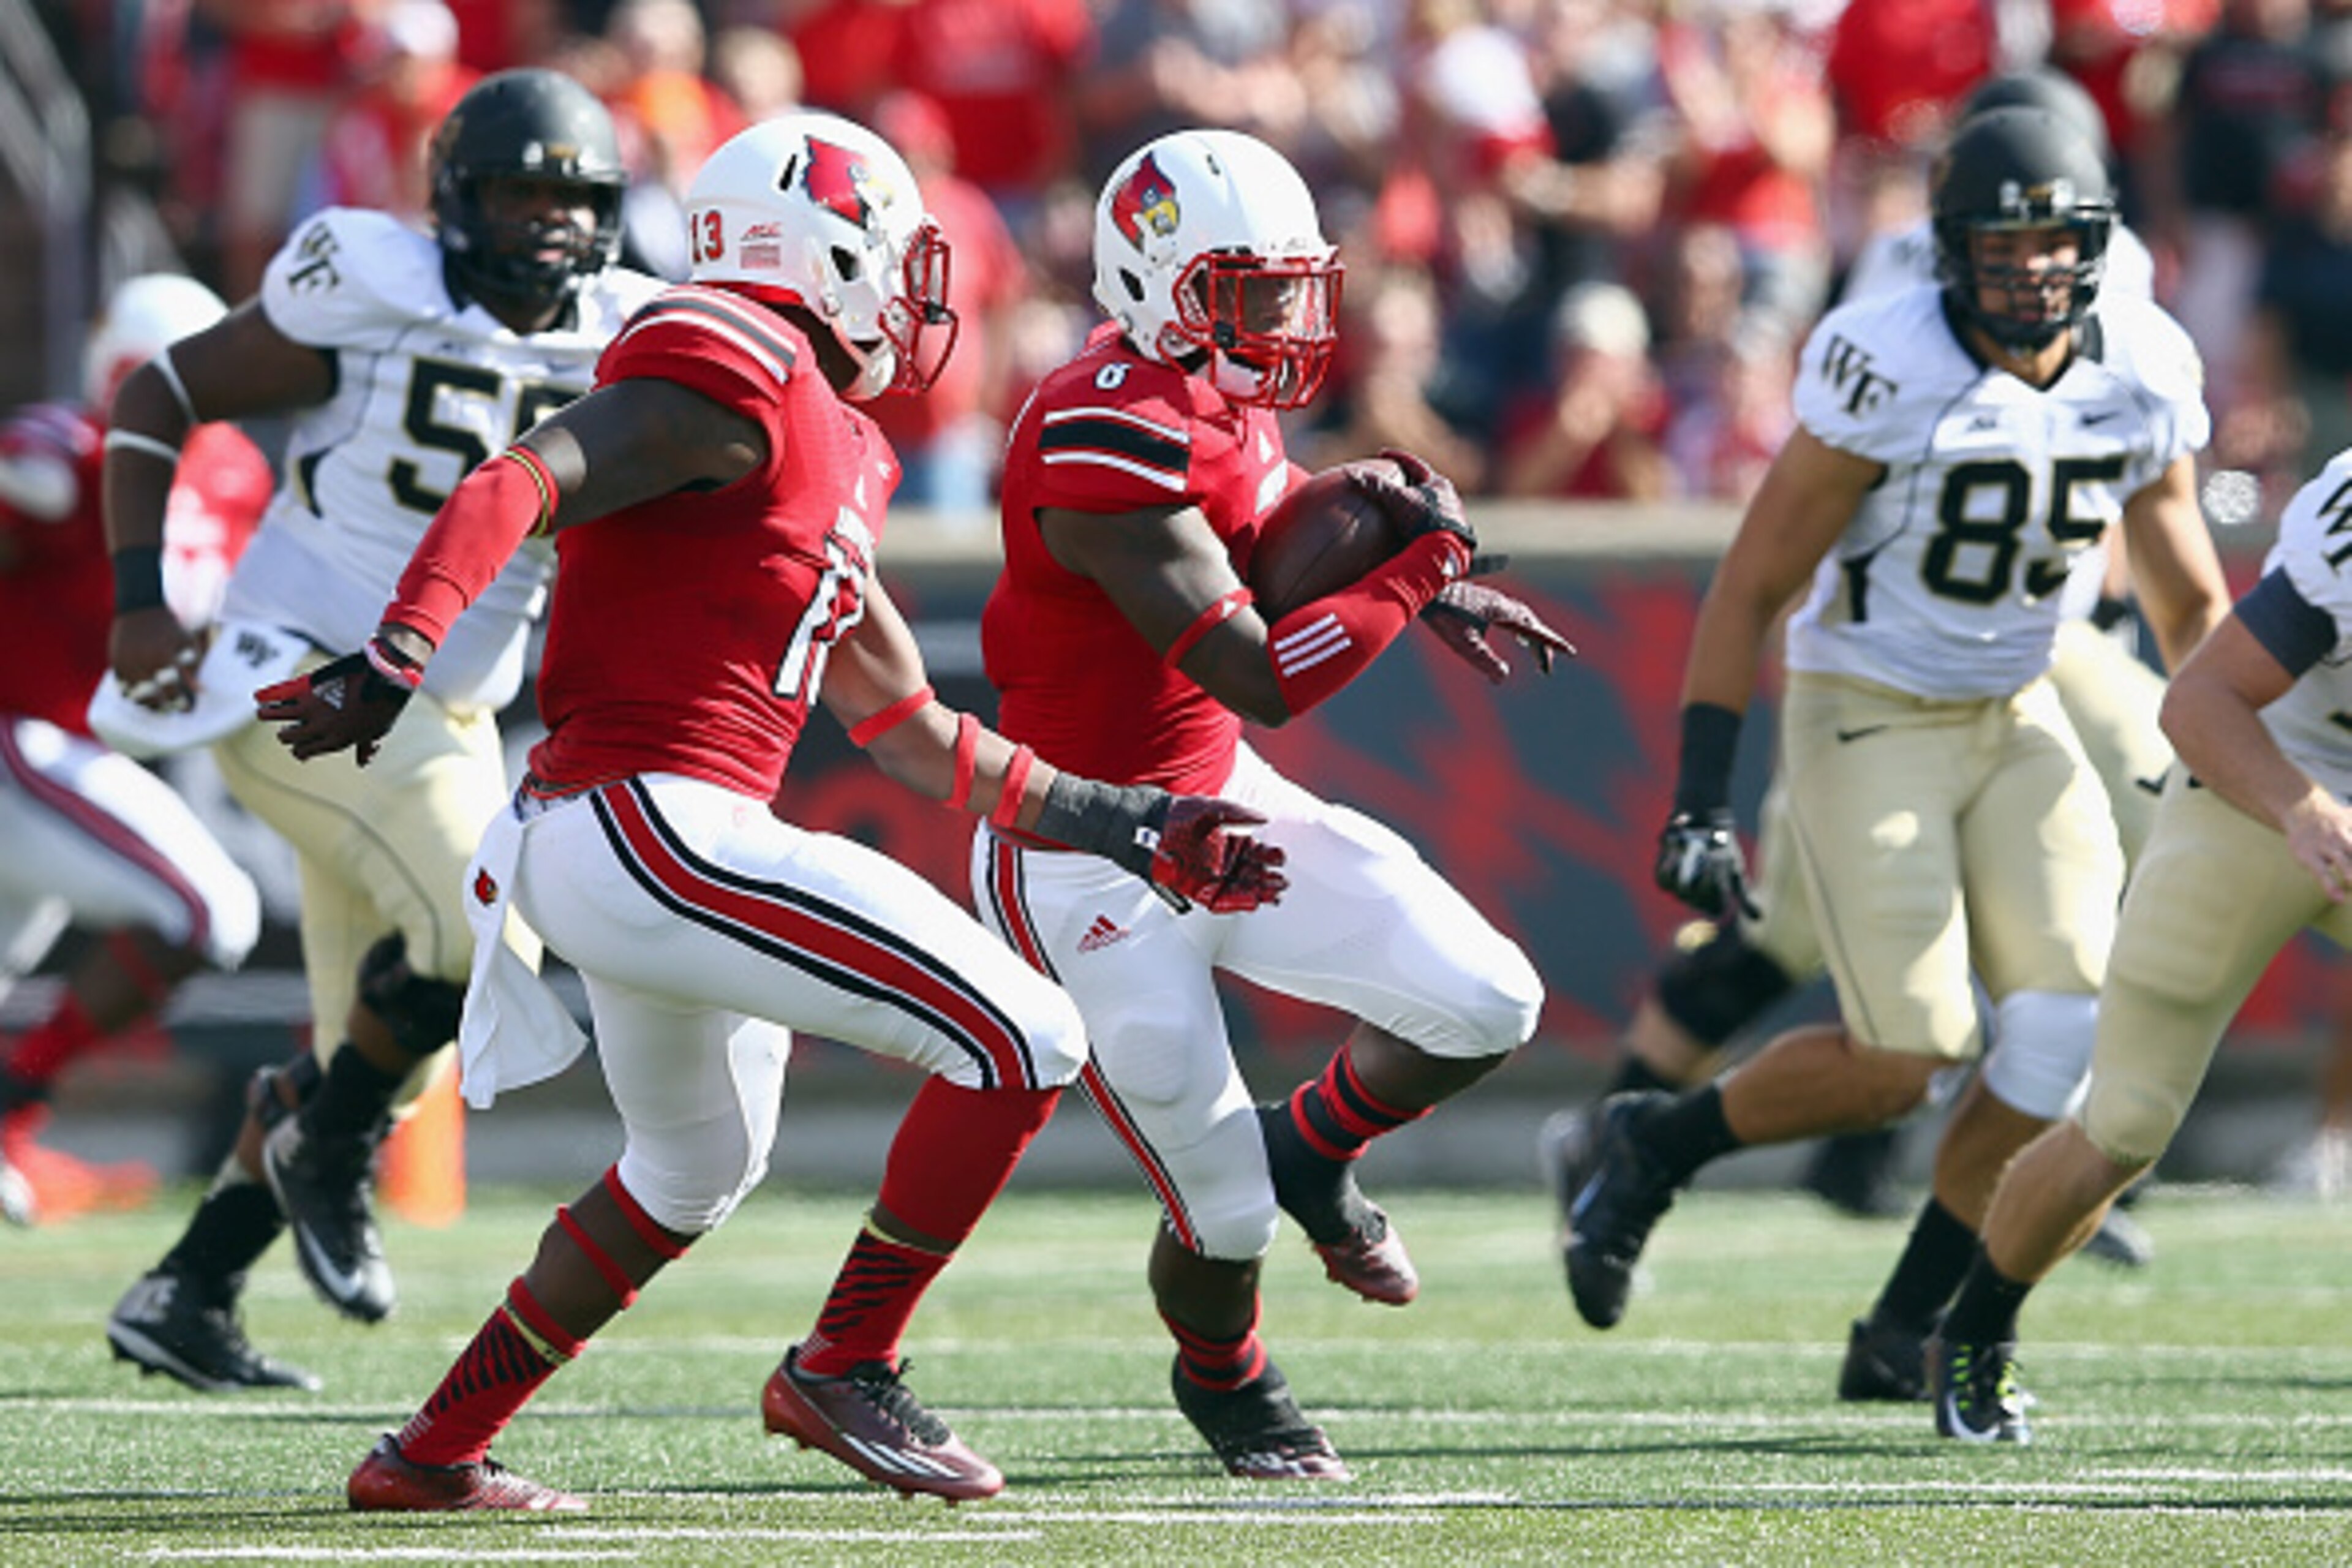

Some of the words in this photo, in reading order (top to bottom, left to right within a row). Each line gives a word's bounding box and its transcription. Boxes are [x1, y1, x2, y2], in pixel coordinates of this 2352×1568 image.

[692, 210, 724, 265] 13
[386, 354, 589, 516] 5
[1820, 333, 1898, 419] WF
[1921, 453, 2128, 608] 85
